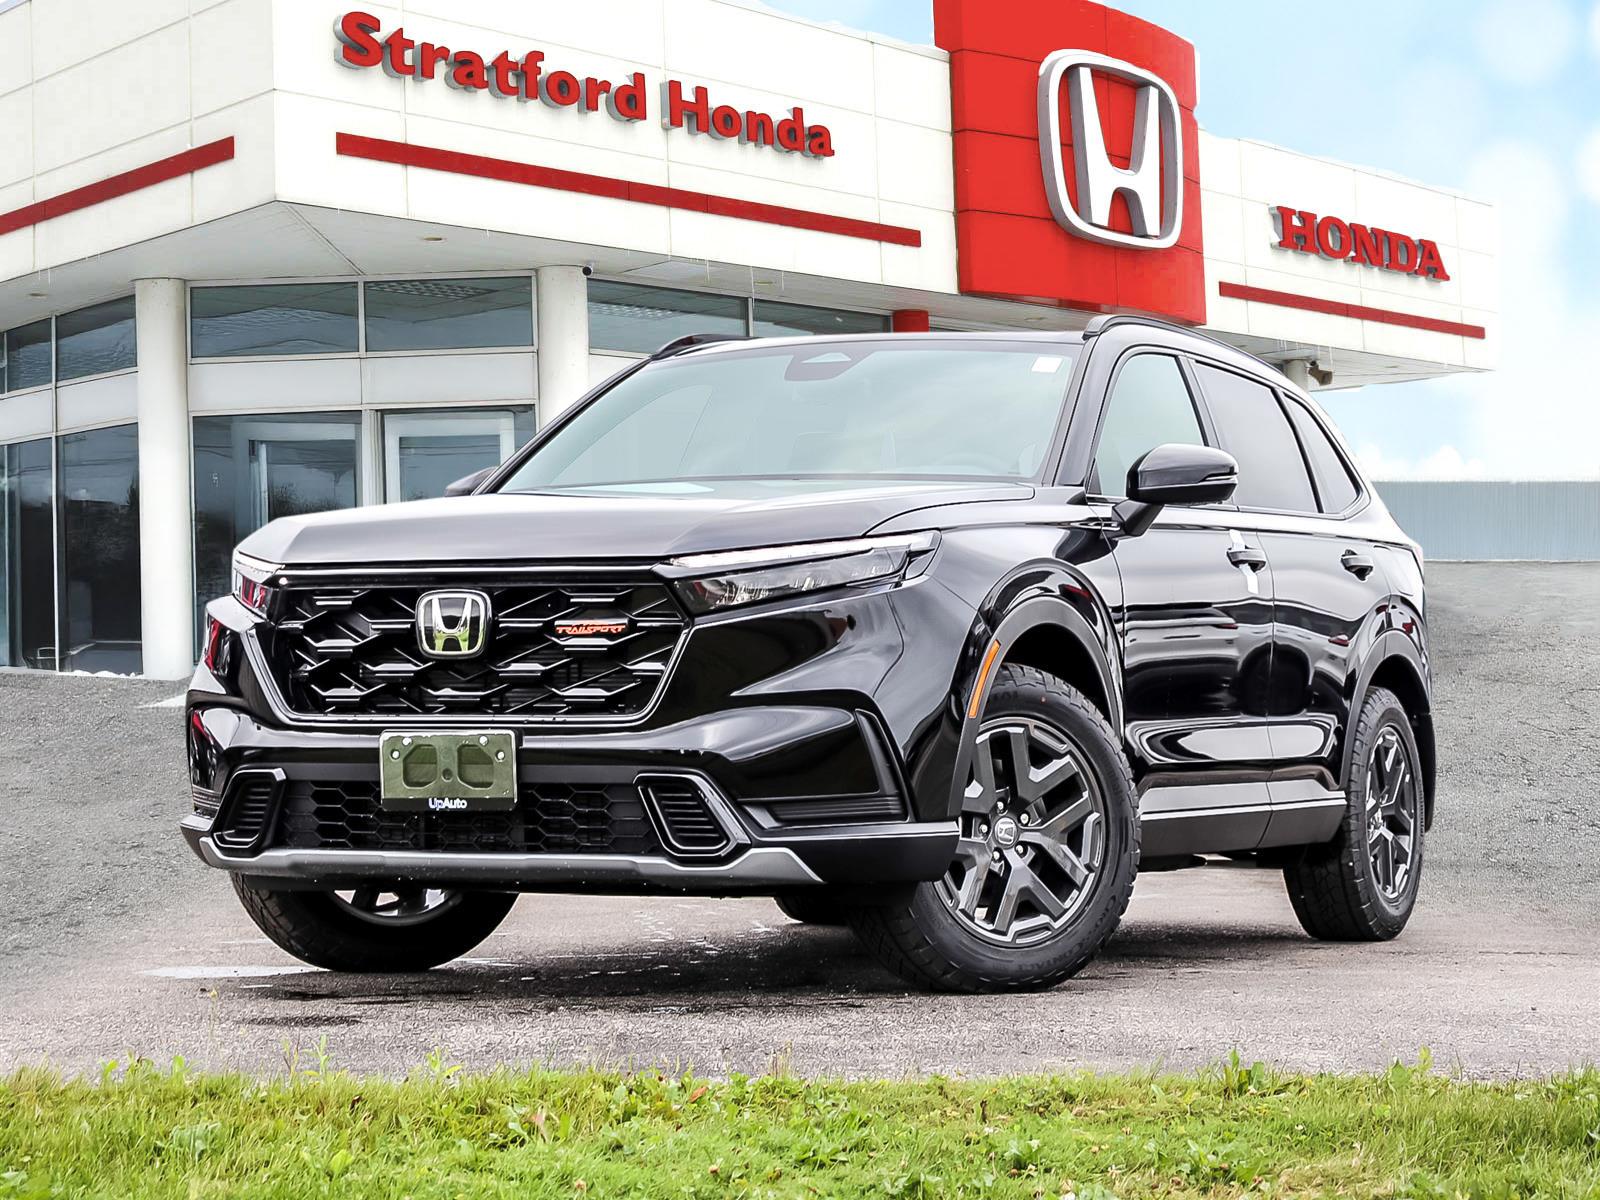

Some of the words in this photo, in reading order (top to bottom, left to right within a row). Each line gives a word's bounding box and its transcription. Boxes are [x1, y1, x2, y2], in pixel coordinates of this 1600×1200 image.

[335, 11, 647, 122] Stratford
[662, 80, 835, 158] Honda
[1269, 205, 1450, 282] HONDA
[428, 797, 468, 811] UpAuto
